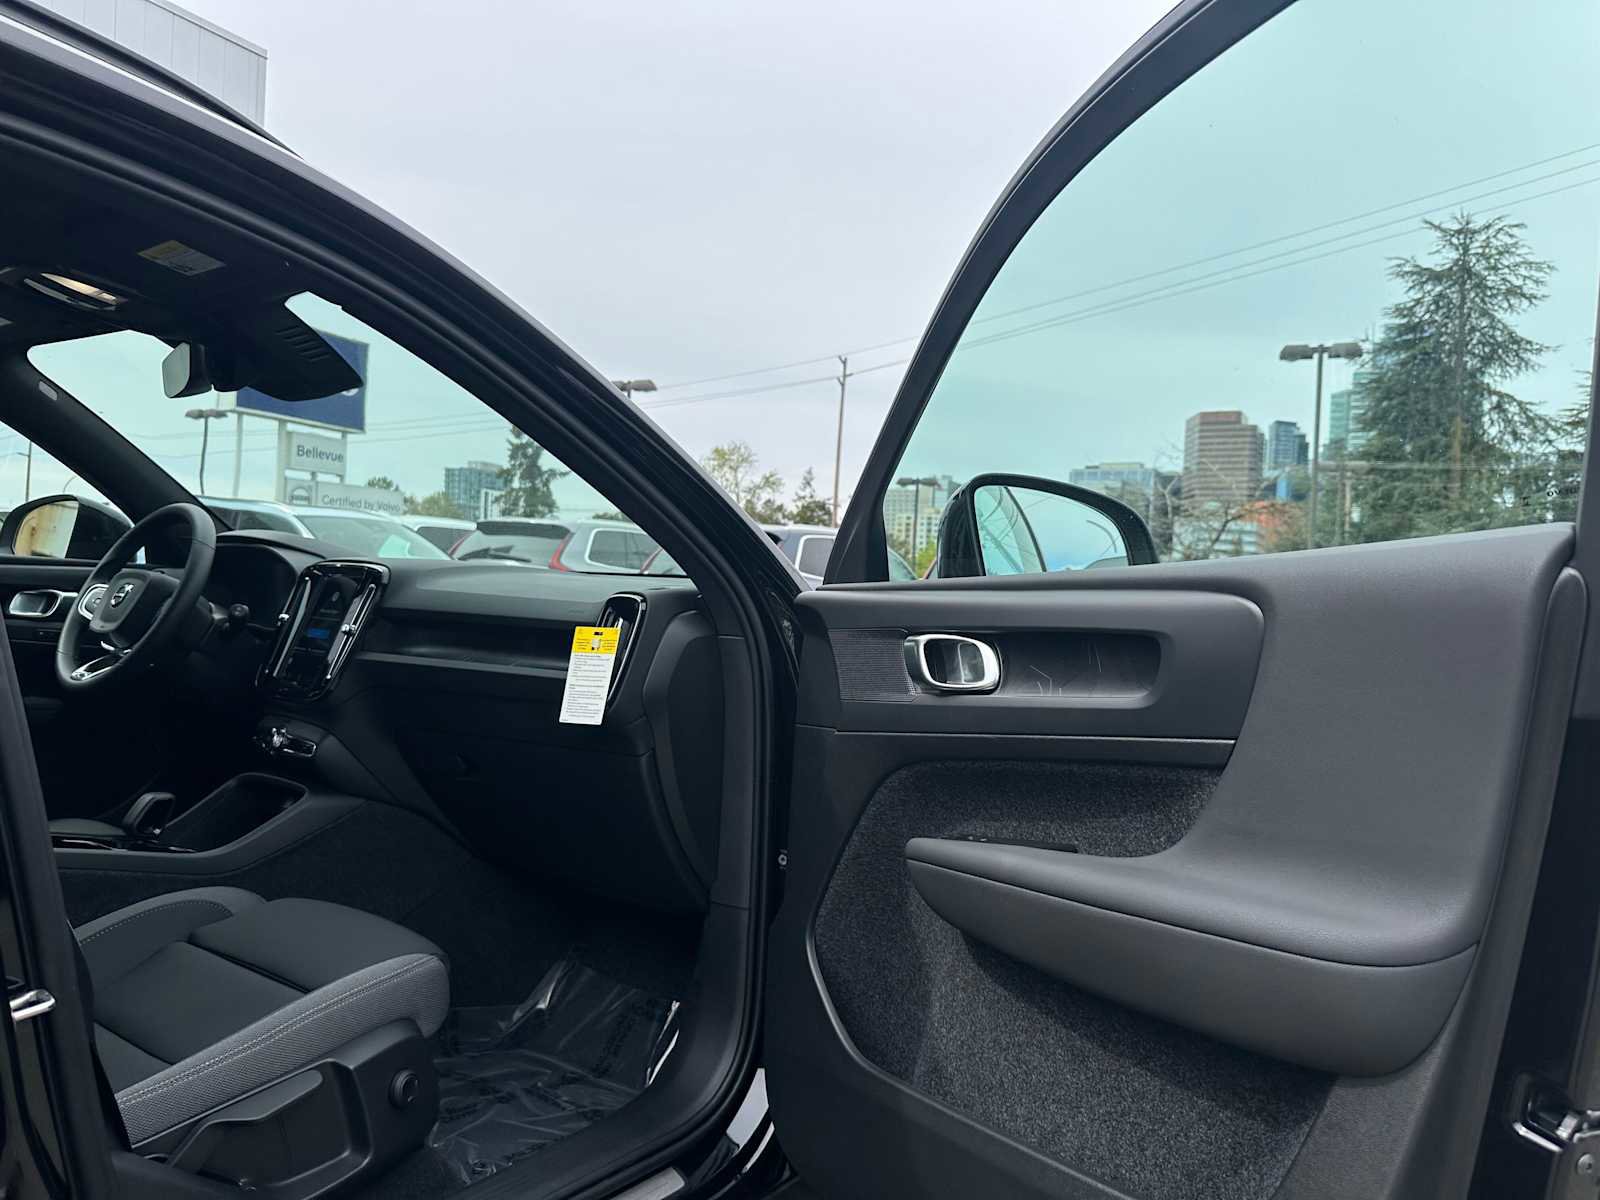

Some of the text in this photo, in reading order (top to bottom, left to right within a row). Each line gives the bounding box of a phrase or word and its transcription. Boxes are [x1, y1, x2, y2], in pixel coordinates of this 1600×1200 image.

[297, 445, 344, 463] Bellevue
[322, 494, 362, 509] Certified
[364, 499, 375, 511] by
